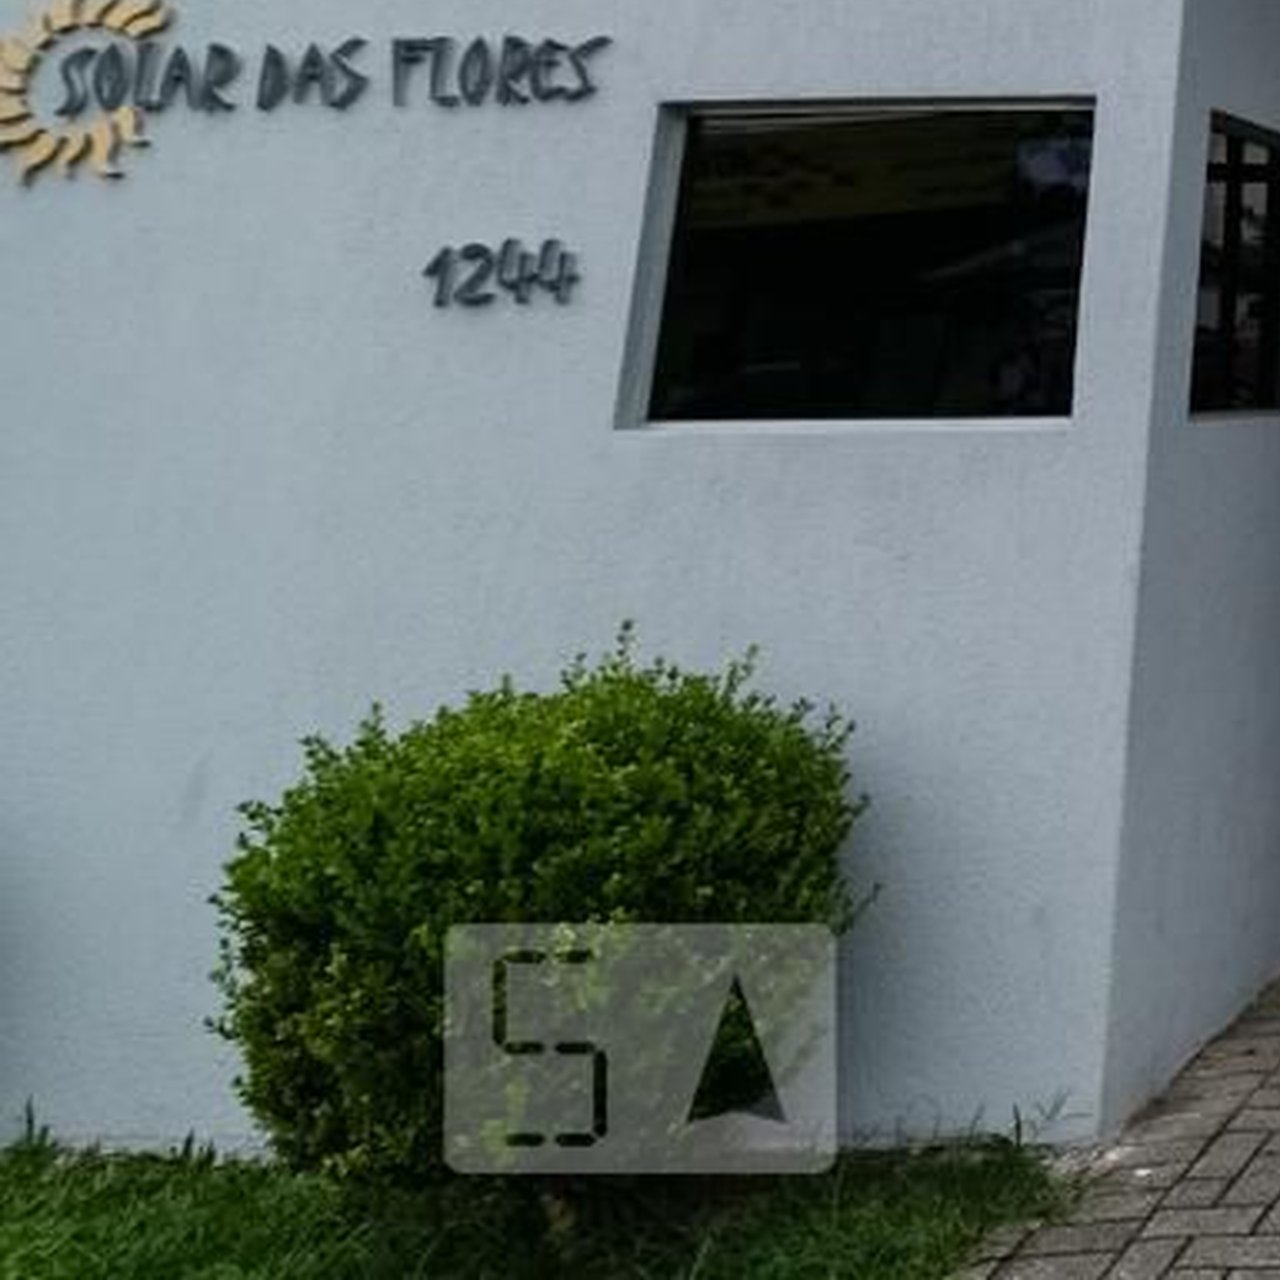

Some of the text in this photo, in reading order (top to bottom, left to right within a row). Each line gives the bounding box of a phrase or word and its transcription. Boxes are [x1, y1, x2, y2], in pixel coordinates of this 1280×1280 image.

[54, 34, 612, 116] SOLAR DAS FLORES
[422, 237, 581, 308] 1244
